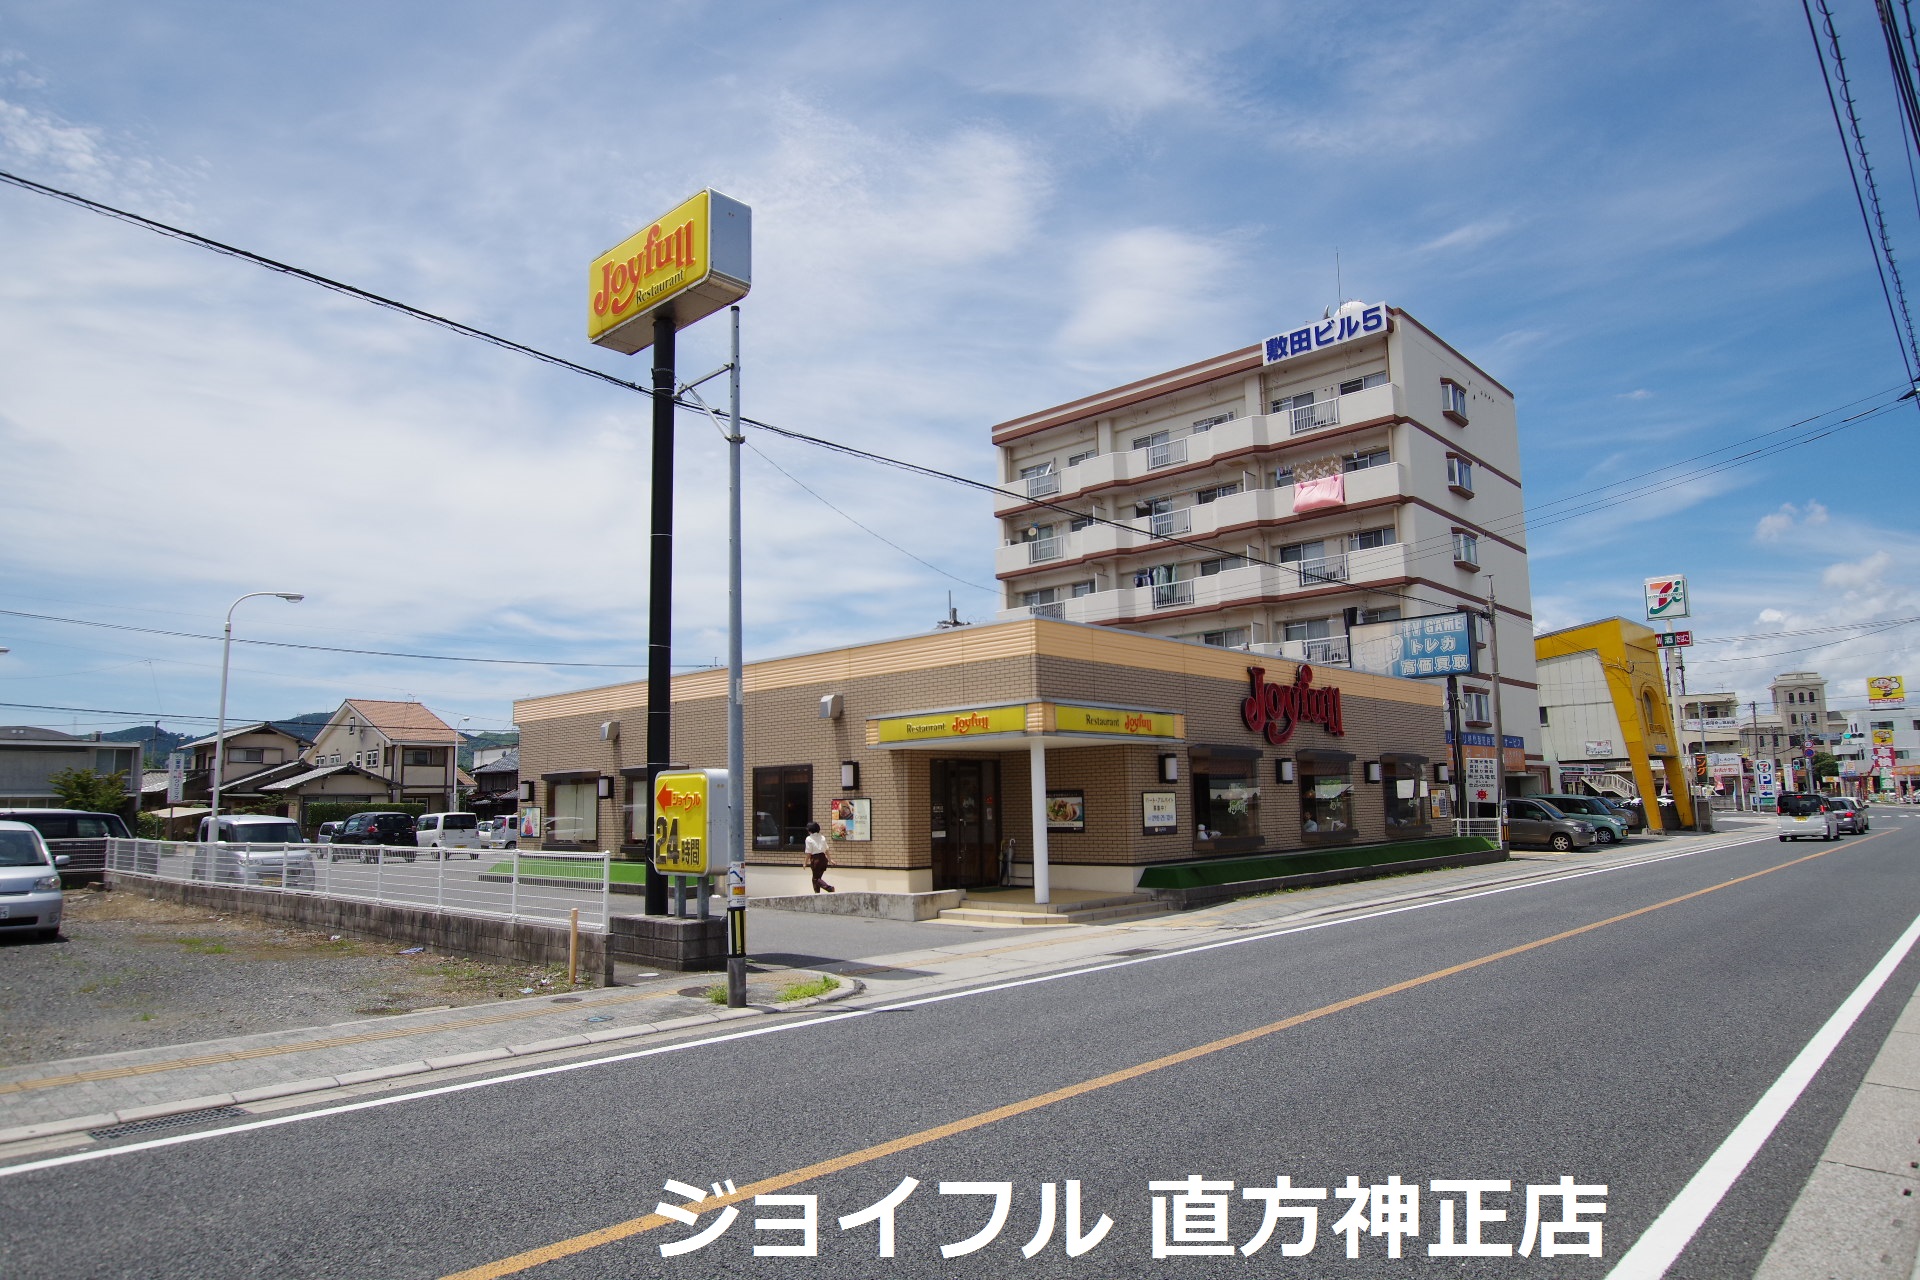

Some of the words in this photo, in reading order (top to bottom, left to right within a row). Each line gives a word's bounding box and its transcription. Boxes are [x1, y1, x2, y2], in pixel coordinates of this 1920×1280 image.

[593, 219, 696, 316] Joyfull
[636, 269, 684, 304] Restaurant
[1265, 306, 1382, 362] 敷田ビル5
[1402, 620, 1421, 637] TV
[1424, 616, 1464, 634] GAME
[1410, 635, 1456, 655] トレカ
[1401, 654, 1469, 675] 高価買取
[1241, 664, 1344, 746] Joyfull
[906, 722, 946, 734] Restaurant
[952, 712, 990, 733] Joyfull
[1085, 714, 1119, 727] Restaurant
[1124, 714, 1152, 732] Joyfull
[673, 793, 701, 811] ジョイフル
[656, 817, 681, 865] 24
[682, 838, 700, 865] 時間
